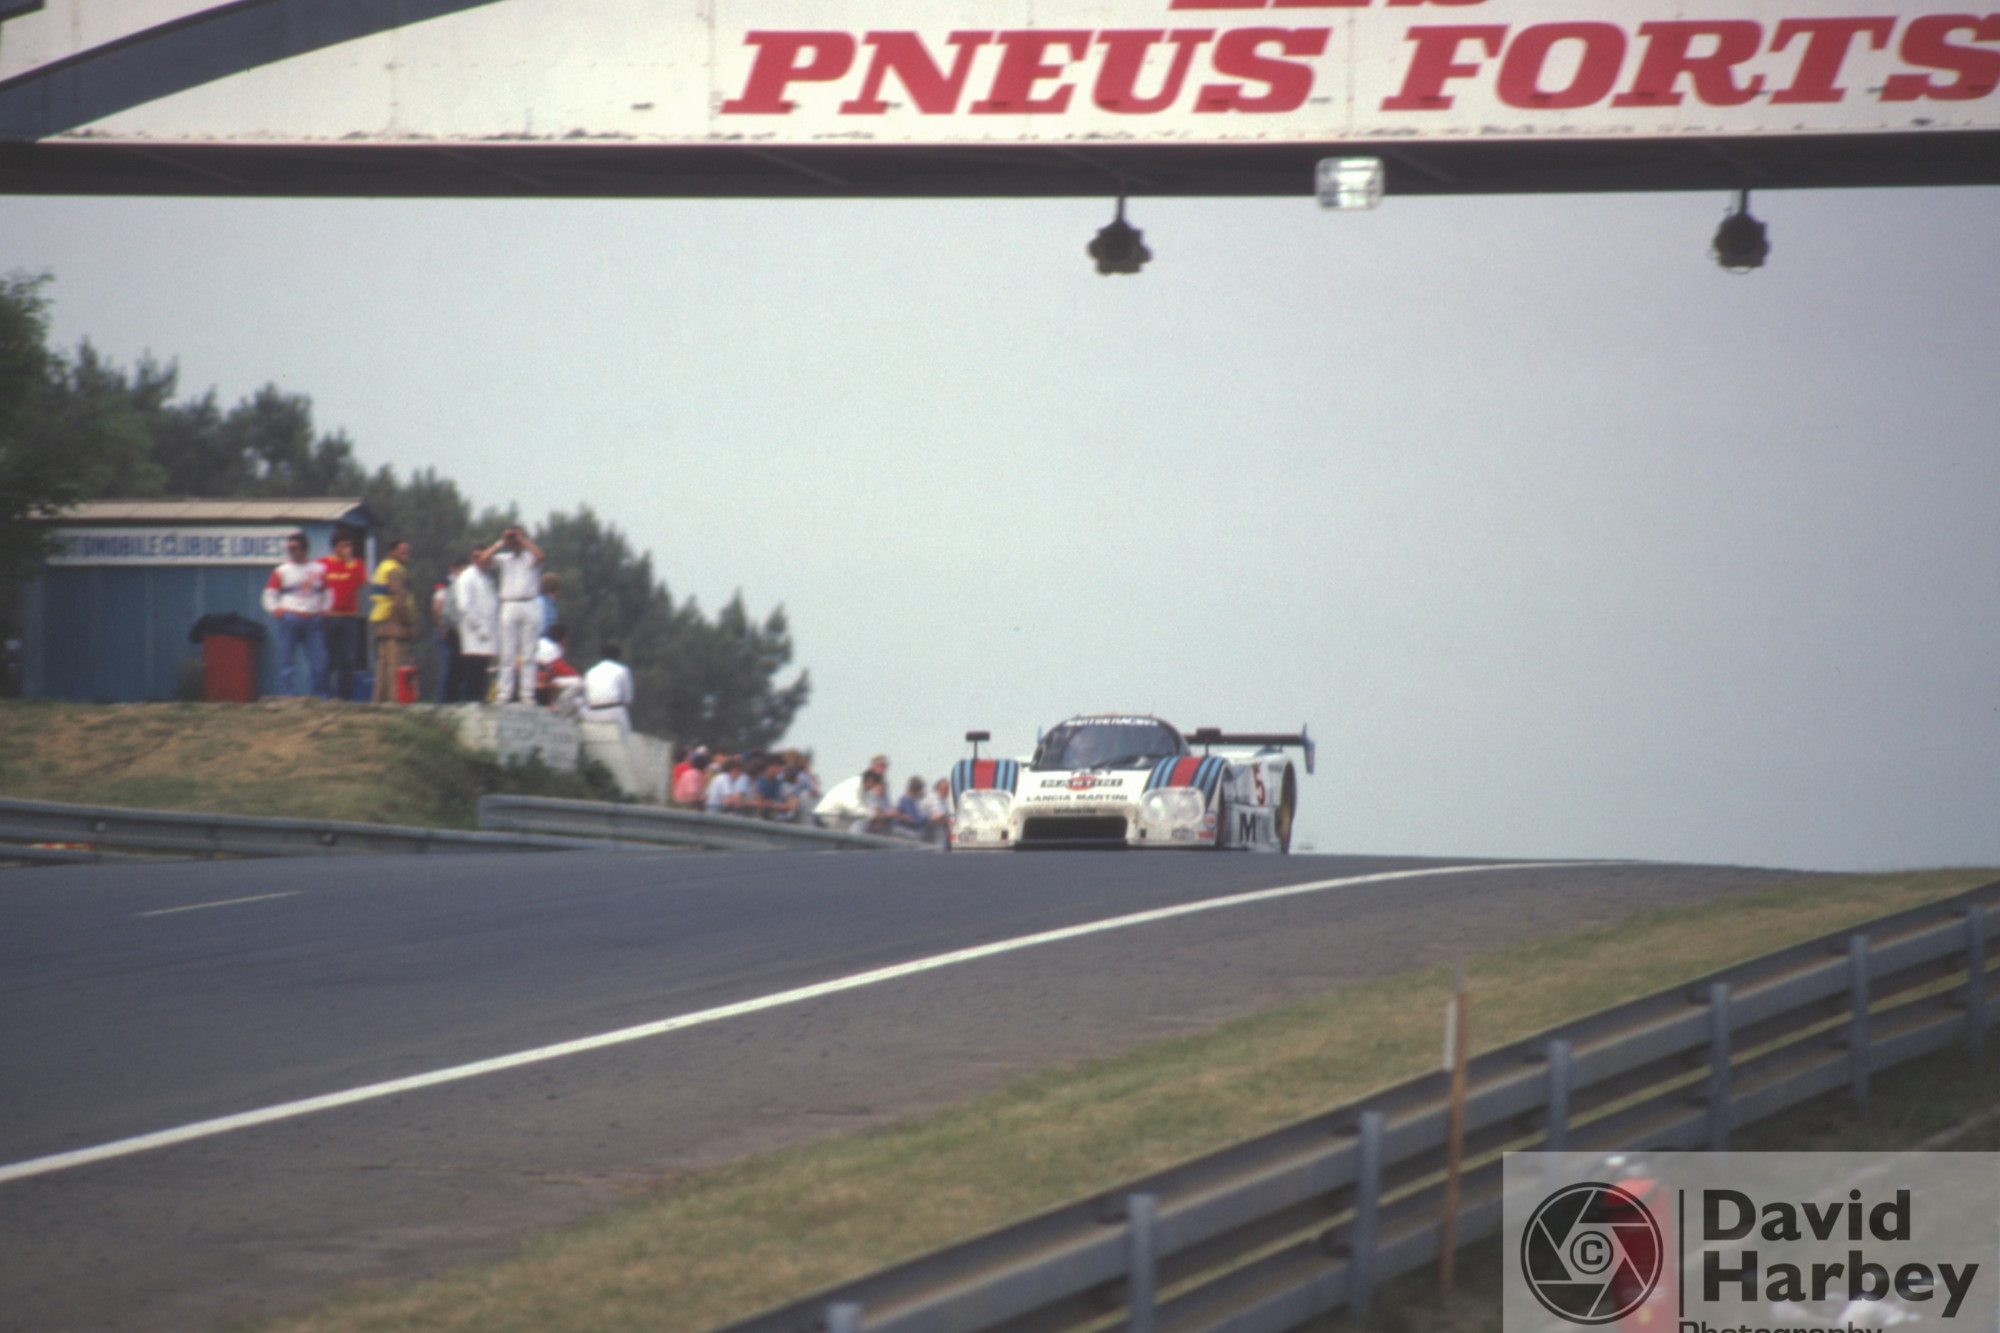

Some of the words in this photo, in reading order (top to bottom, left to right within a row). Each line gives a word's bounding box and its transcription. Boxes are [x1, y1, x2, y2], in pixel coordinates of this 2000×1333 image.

[721, 29, 1332, 115] PNEUS
[1381, 15, 2000, 111] FORTS
[1076, 793, 1128, 801] MARTINI
[1251, 763, 1266, 807] 5
